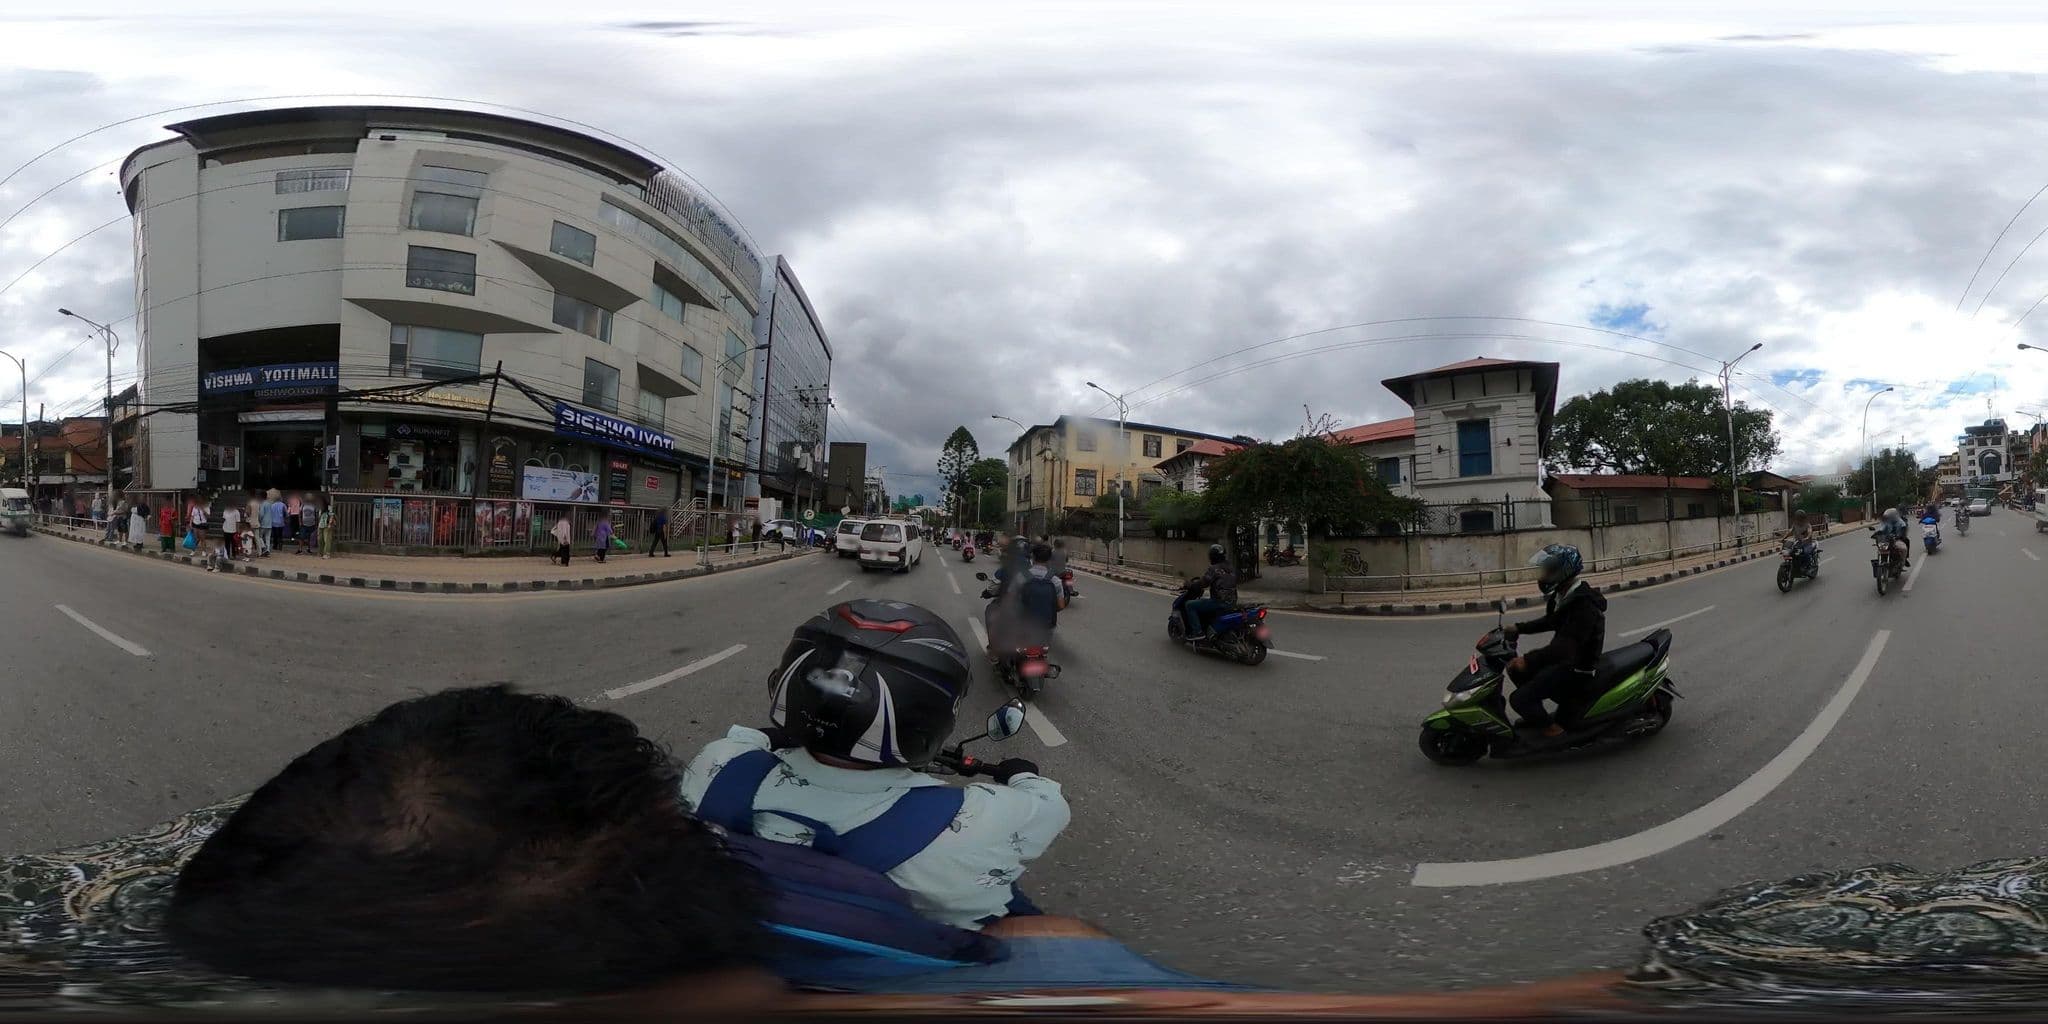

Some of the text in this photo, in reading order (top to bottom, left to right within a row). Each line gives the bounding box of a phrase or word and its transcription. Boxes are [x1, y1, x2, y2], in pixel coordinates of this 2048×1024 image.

[204, 366, 338, 390] VISHWA YOTI MALL
